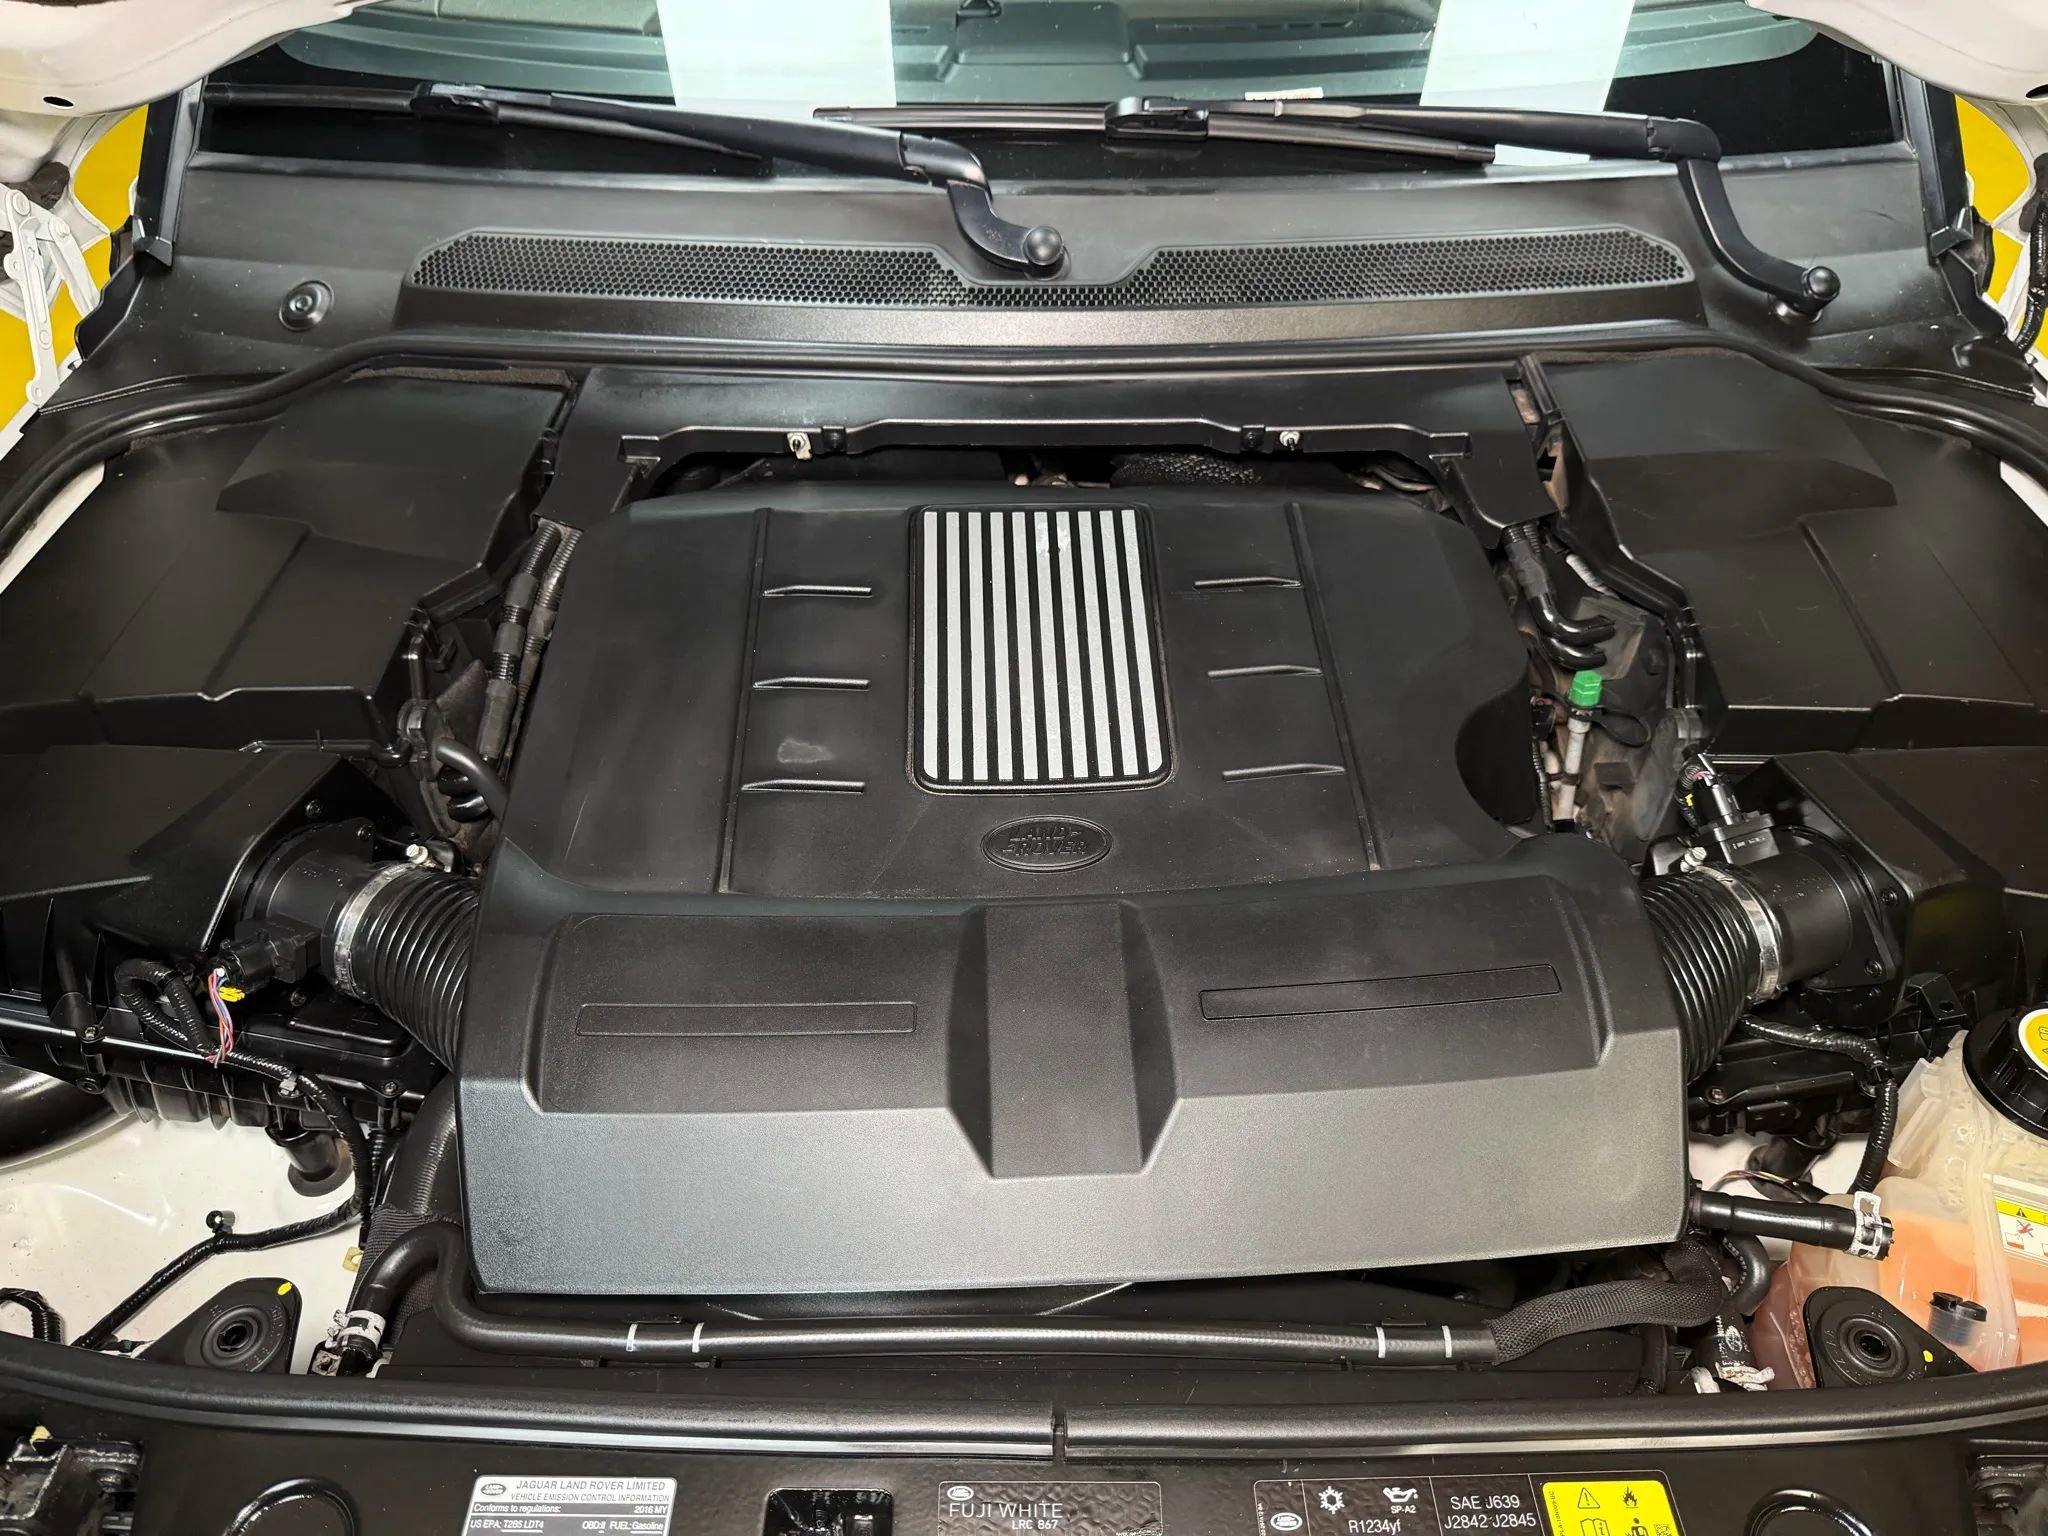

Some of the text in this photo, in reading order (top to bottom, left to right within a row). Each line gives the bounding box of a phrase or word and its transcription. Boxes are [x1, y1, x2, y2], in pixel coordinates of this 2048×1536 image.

[516, 1480, 558, 1489] JAGUAR
[560, 1480, 587, 1490] LAND
[590, 1481, 624, 1490] ROVER
[626, 1481, 666, 1491] LIMITED
[511, 1493, 670, 1502] VEHICLE EMISSION CONTROL INFORMATION
[1450, 1494, 1520, 1510] SAE J639
[474, 1503, 668, 1514] Conforms to regulations: 2016 MY
[949, 1503, 1063, 1518] FUJI WHITE
[1390, 1505, 1417, 1514] SP-A2
[470, 1519, 482, 1528] US
[483, 1520, 502, 1528] EPA:
[523, 1520, 544, 1529] LDT4
[1012, 1519, 1058, 1530] LRC 867
[1444, 1512, 1537, 1529] J2842 J2845
[1348, 1518, 1401, 1535] R1234yf
